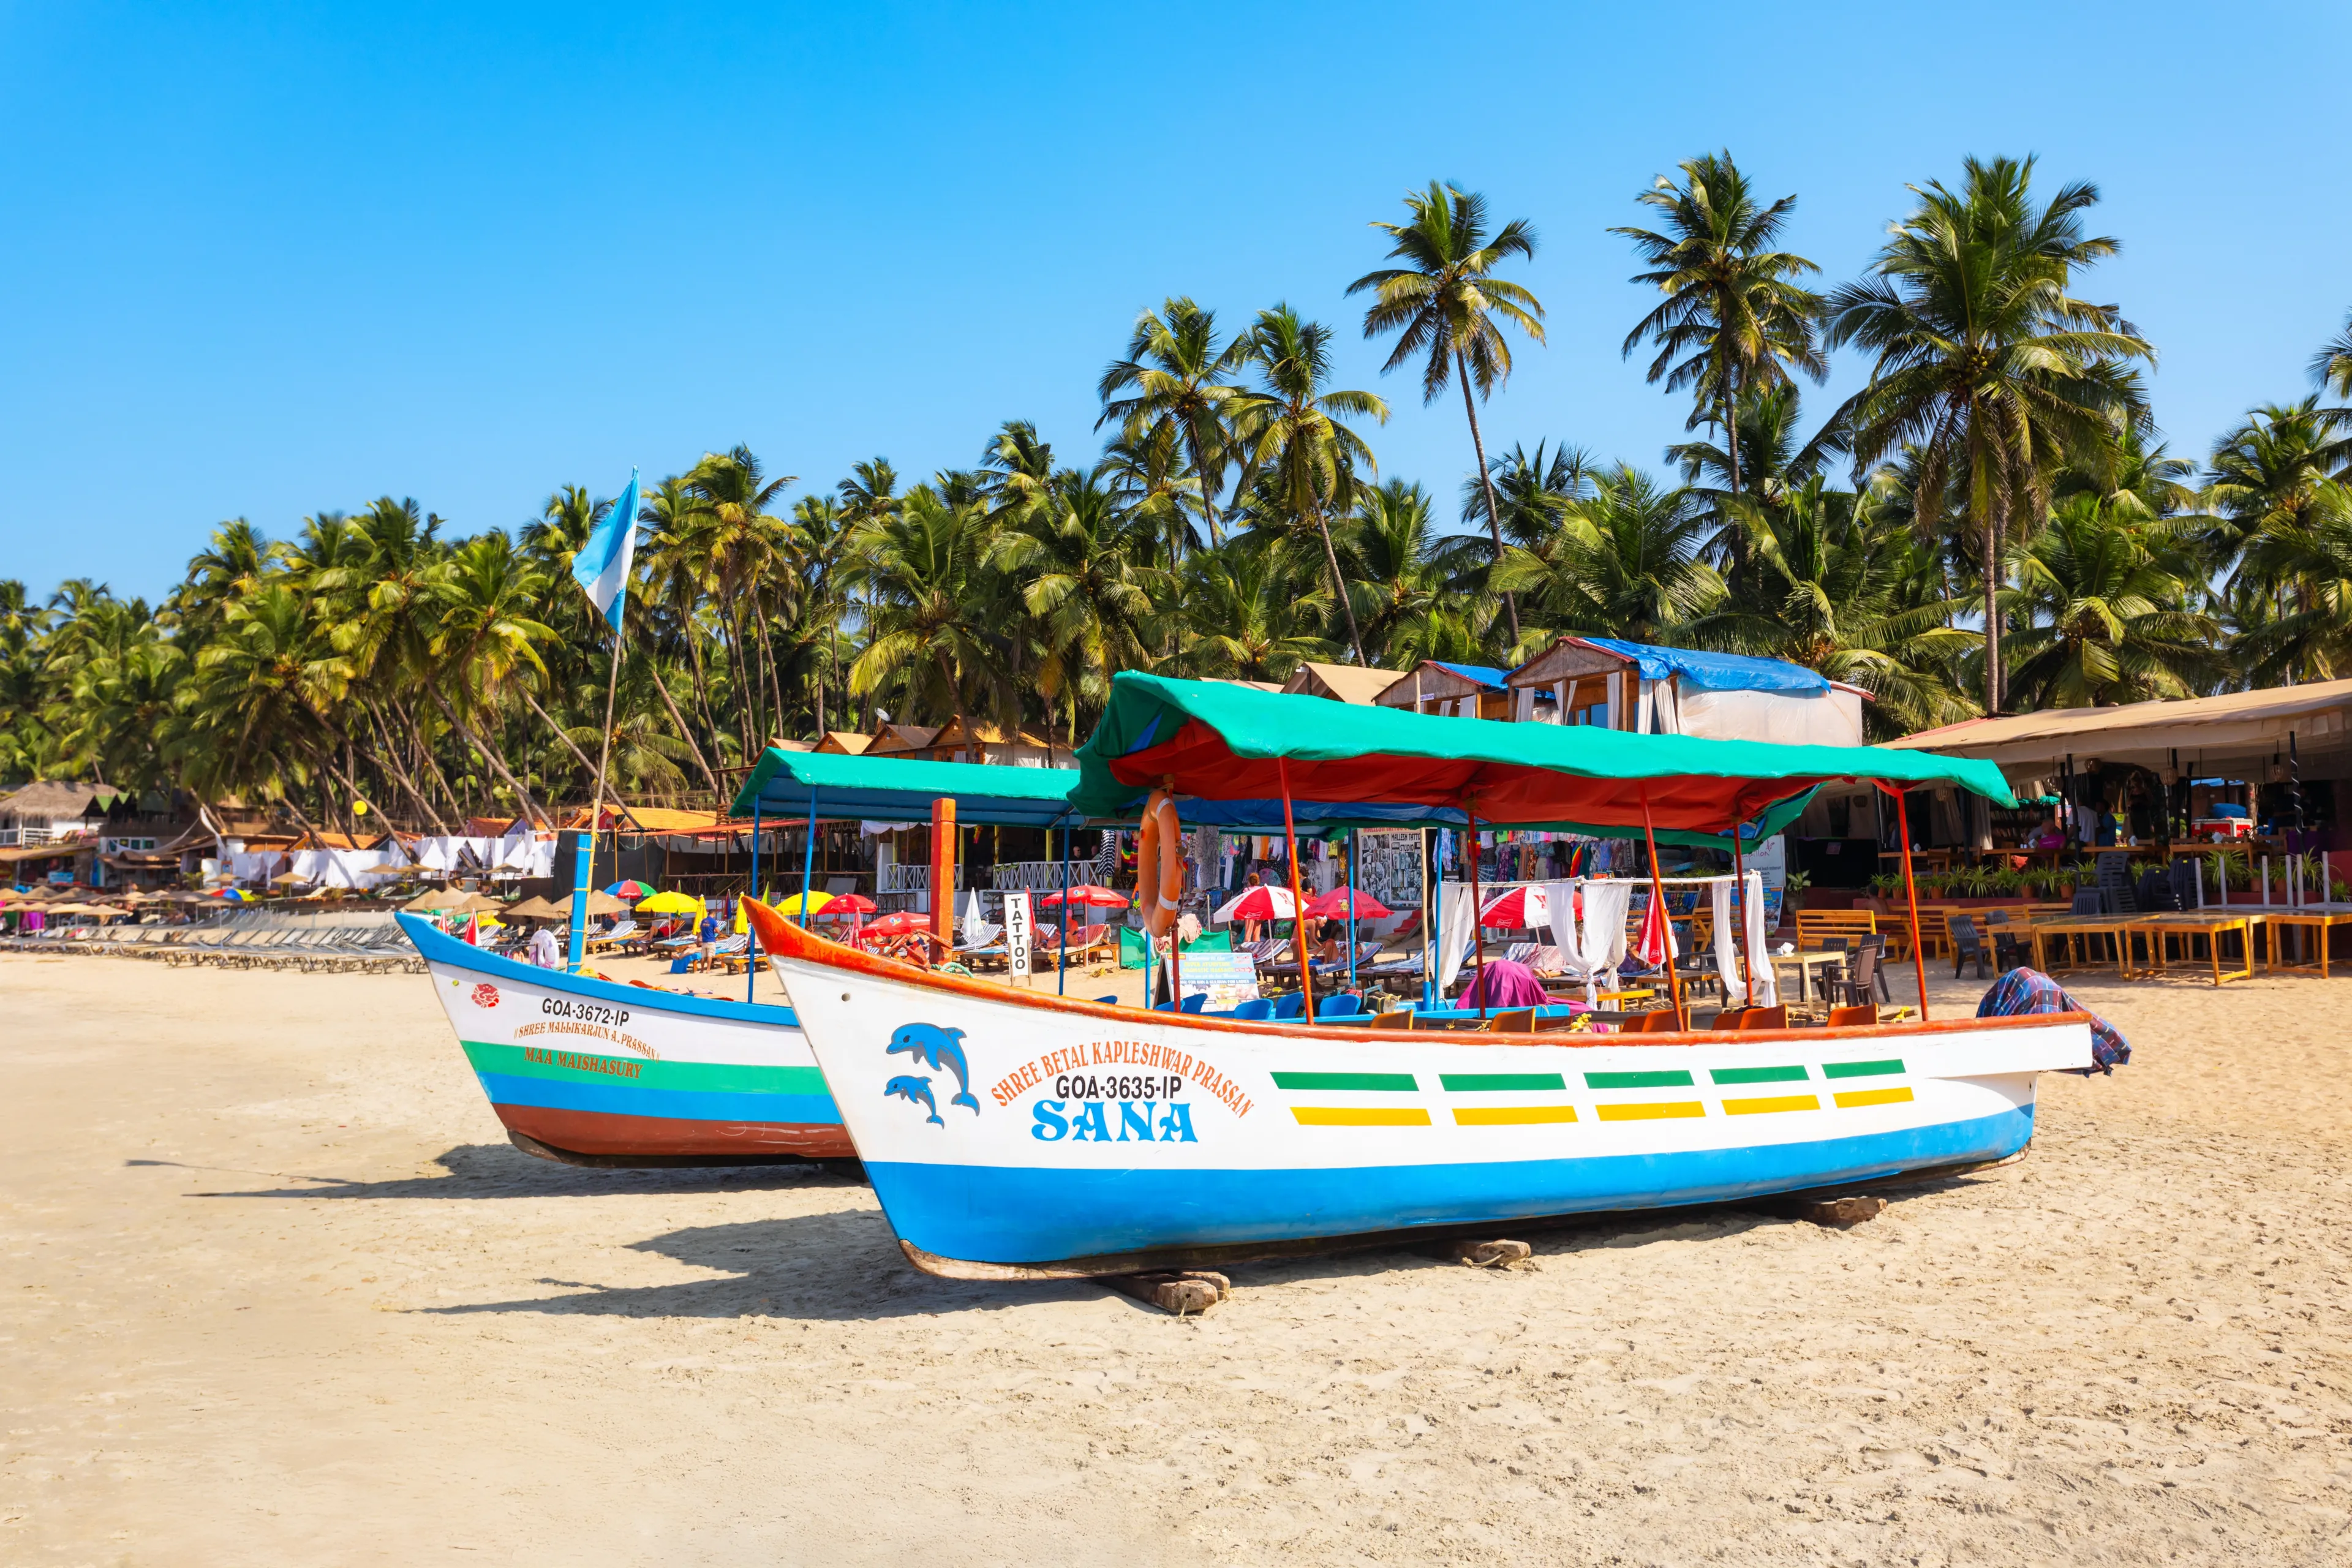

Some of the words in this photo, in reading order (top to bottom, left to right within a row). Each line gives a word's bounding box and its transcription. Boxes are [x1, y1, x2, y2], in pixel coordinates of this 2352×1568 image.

[1742, 850, 1770, 862] pillon
[1011, 898, 1025, 969] TATTOO
[543, 998, 630, 1027] GOA-3672-IP
[519, 1022, 546, 1038] SHREE
[547, 1021, 610, 1040] MALLIKARJUN
[524, 1046, 553, 1065] MAA
[557, 1051, 644, 1079] MAISHASURY
[991, 1061, 1042, 1107] SHREE
[1041, 1044, 1089, 1078] BETAL
[1092, 1041, 1193, 1077] KAPLESHWAR
[1191, 1060, 1254, 1118] PRASSAN
[1056, 1075, 1182, 1099] GOA-3635-IP
[1031, 1099, 1199, 1143] SANA
